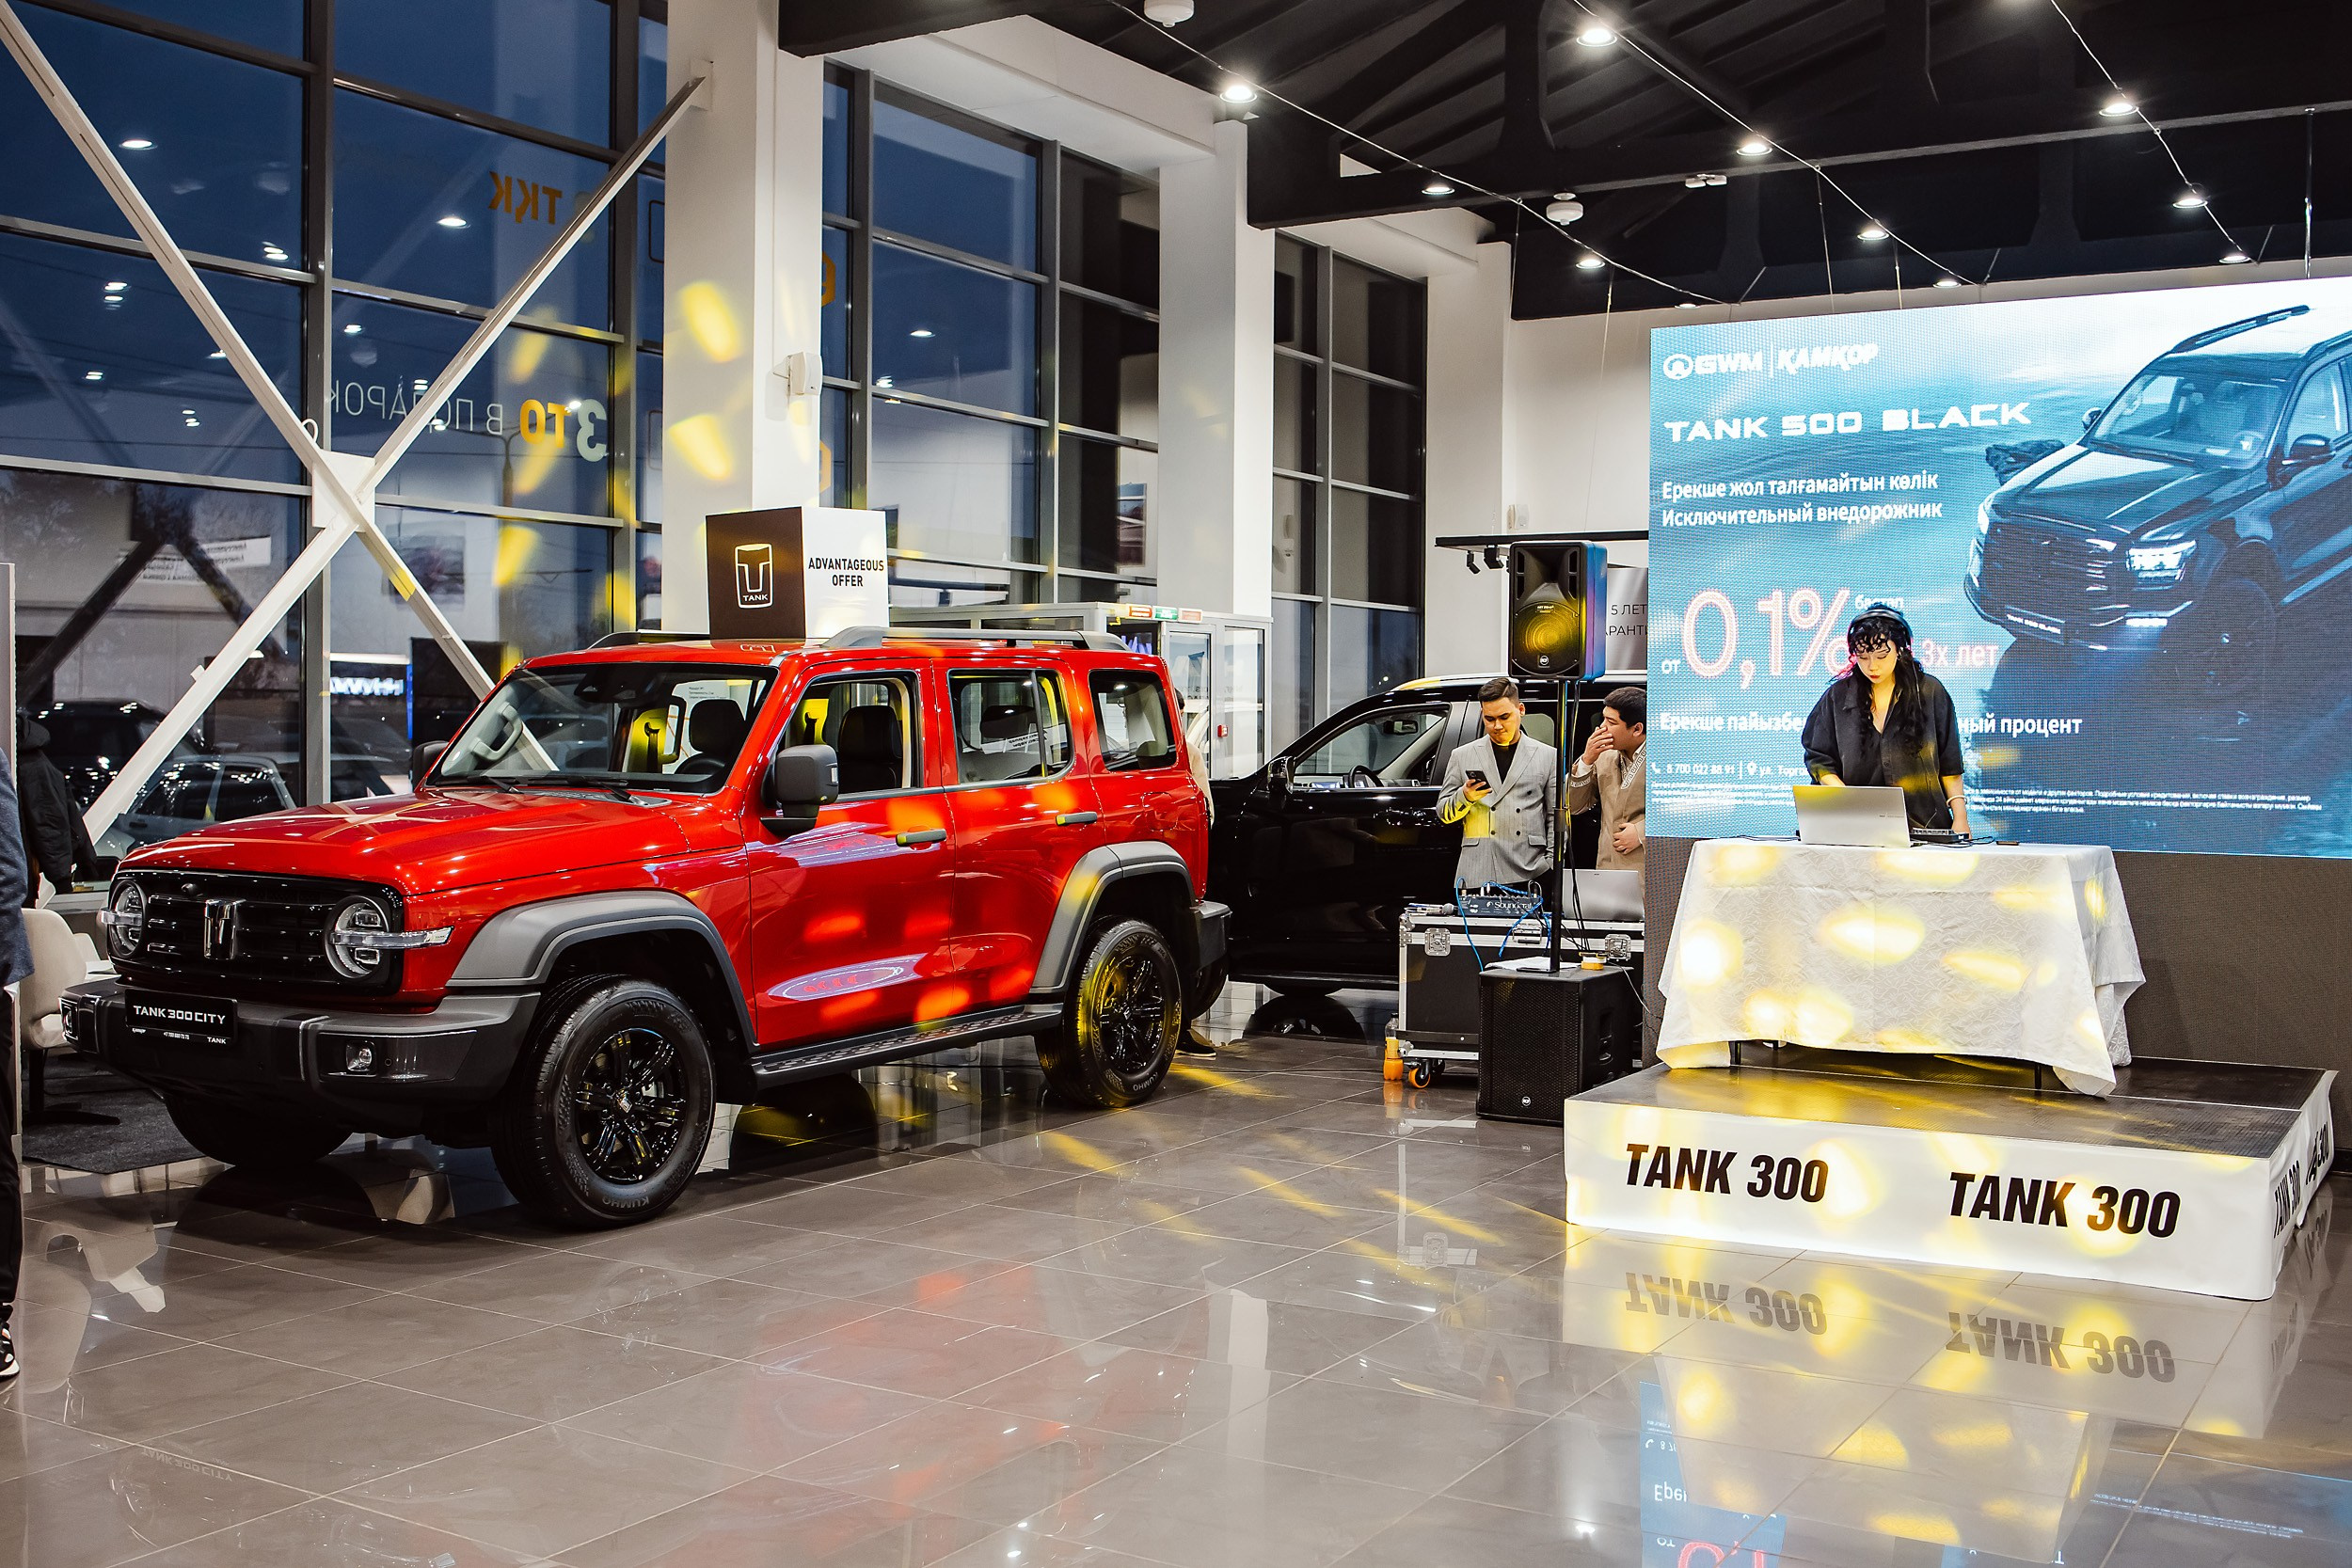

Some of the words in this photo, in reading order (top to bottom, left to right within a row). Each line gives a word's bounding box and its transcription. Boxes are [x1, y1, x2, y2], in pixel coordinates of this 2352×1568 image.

[1694, 352, 1762, 374] GWM
[1663, 416, 1769, 443] TANK
[1781, 411, 1863, 436] 500
[1882, 402, 2032, 432] BLACK
[1662, 481, 1726, 502] Ерекше
[1729, 482, 1764, 499] жол
[1768, 473, 1883, 496] талғамайтын
[1889, 470, 1938, 491] көлік
[1662, 502, 1813, 528] Исключительный
[1817, 503, 1943, 528] внедорожник
[808, 557, 884, 571] ADVANTAGEOUS
[832, 575, 863, 587] OFFER
[742, 594, 768, 602] TANK
[1611, 605, 1617, 615] 5
[1621, 604, 1647, 615] ЛЕТ
[1956, 645, 1999, 667] лет
[1661, 659, 1680, 675] от
[1660, 711, 1724, 734] Ерекше
[2000, 716, 2083, 737] процент
[133, 1005, 166, 1018] TANK
[167, 1009, 192, 1022] 300
[194, 1011, 226, 1024] CITY
[1625, 1143, 1738, 1195] TANK
[1746, 1154, 1829, 1203] 300
[602, 1196, 650, 1209] KUMHO
[1948, 1171, 2075, 1227] TANK
[2087, 1185, 2182, 1238] 300
